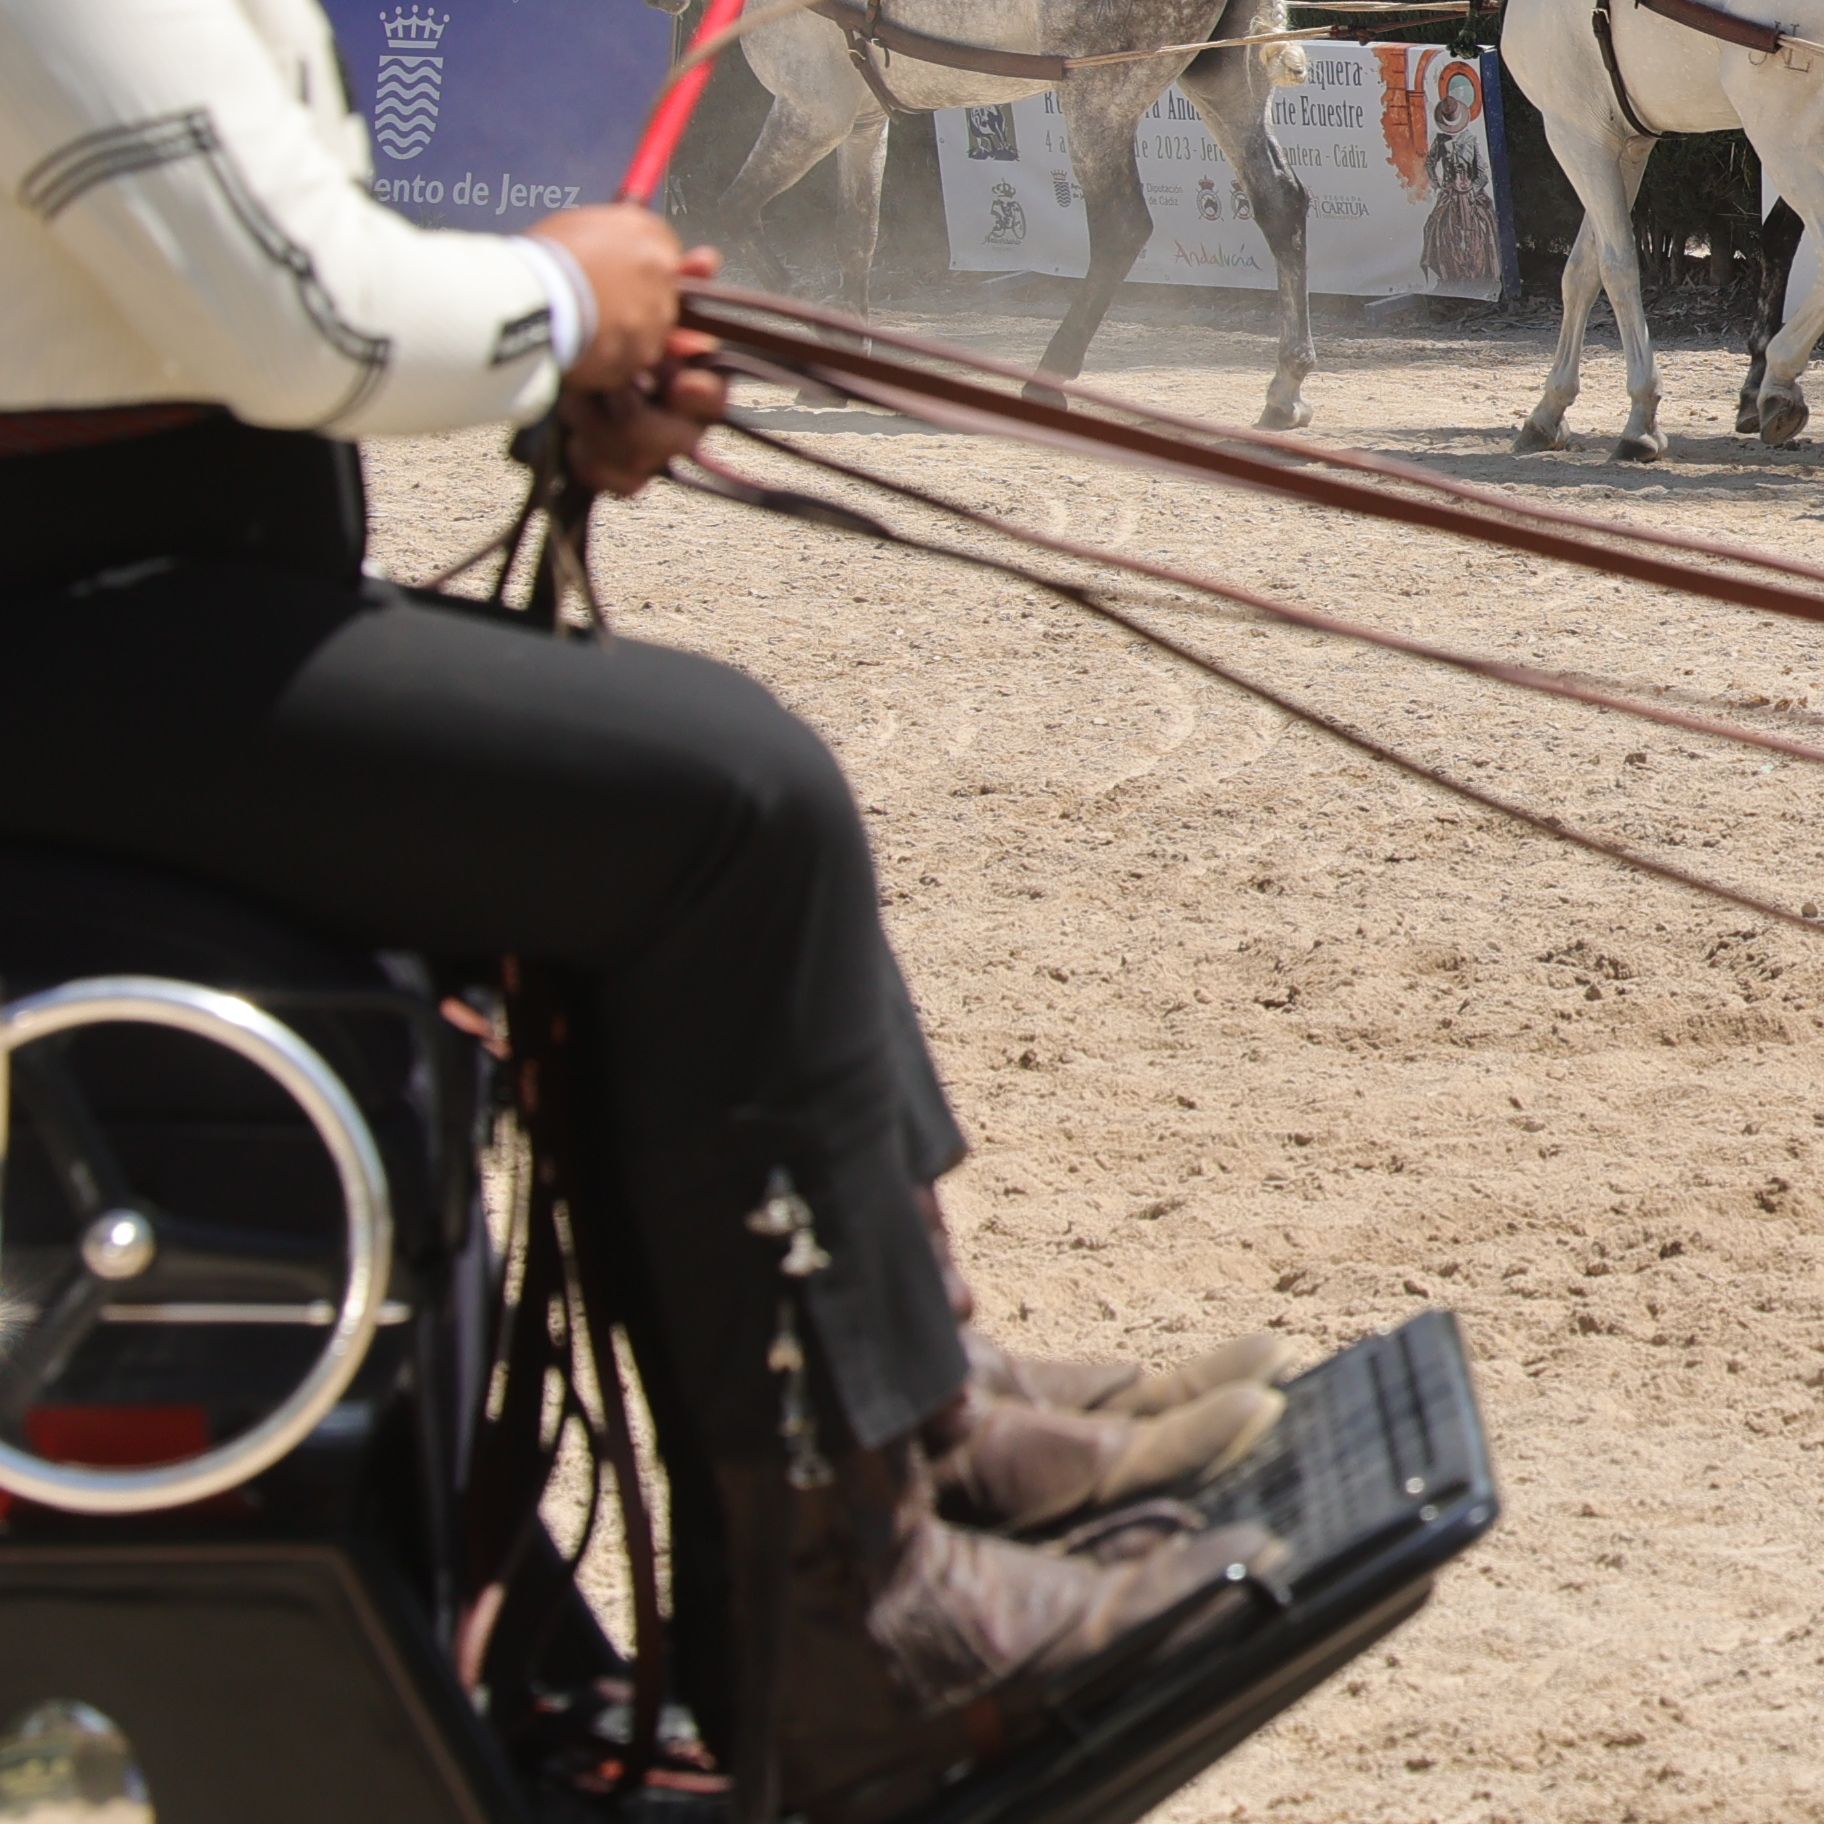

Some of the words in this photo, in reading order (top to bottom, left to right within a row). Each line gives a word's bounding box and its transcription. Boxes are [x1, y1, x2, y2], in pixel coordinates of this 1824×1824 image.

[1300, 95, 1364, 129] Ecuestre
[1333, 142, 1368, 169] Cádiz
[374, 174, 444, 204] ento
[452, 171, 489, 206] de
[495, 173, 580, 216] Jerez
[1321, 200, 1370, 217] CARTUJA
[1174, 239, 1263, 272] Andalucía
